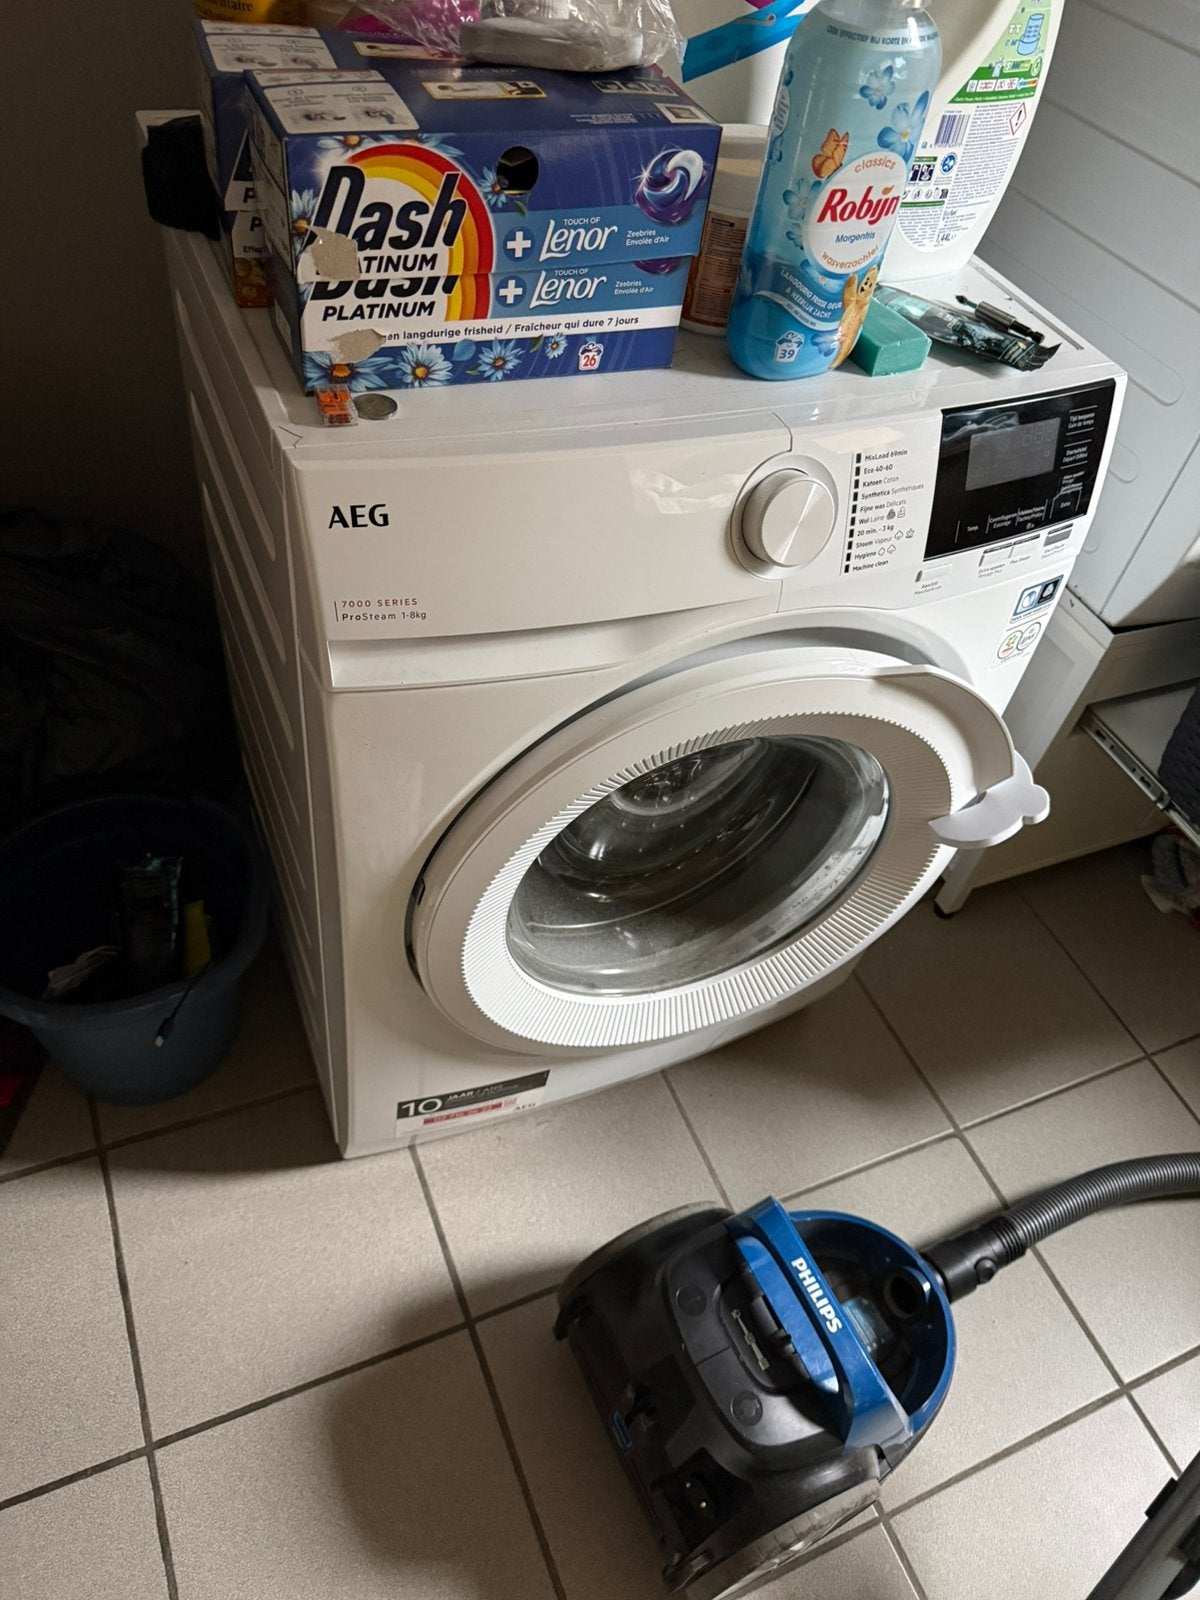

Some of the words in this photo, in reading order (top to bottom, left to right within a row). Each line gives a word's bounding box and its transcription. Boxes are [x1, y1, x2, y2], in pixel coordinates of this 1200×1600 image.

[869, 34, 881, 45] BIJ
[882, 36, 900, 46] KORTE
[854, 156, 897, 174] classics
[302, 165, 467, 252] Dash
[817, 185, 900, 226] Robijn
[564, 218, 589, 226] TOUCH
[590, 217, 600, 225] OF
[626, 229, 656, 238] Zeebries
[835, 231, 875, 244] Morgenfris
[539, 219, 618, 262] Lenor
[626, 238, 653, 247] Envolée
[654, 235, 669, 245] d'Air
[358, 253, 438, 275] TINUM
[555, 269, 578, 277] TOUCH
[579, 268, 589, 276] OF
[529, 270, 607, 310] Lenor
[615, 280, 642, 288] Zeebries
[780, 269, 812, 299] LANGDURIG
[614, 288, 639, 296] Envolée
[640, 286, 654, 294] d'Air
[322, 301, 436, 322] PLATINUM
[385, 332, 400, 341] en
[403, 328, 461, 343] langdurige
[464, 324, 503, 337] frisheid
[514, 321, 561, 333] Fraîcheur
[565, 319, 580, 331] qui
[582, 317, 604, 328] dure
[608, 317, 614, 326] 7
[615, 315, 639, 327] jours
[779, 349, 795, 360] 39
[583, 355, 597, 368] 26
[865, 451, 889, 462] MixLoad
[890, 449, 908, 458] 69min
[864, 466, 874, 475] Eco
[875, 464, 894, 473] 40-60
[862, 478, 882, 488] Katoen
[883, 476, 899, 485] Coton
[861, 489, 890, 500] Synthetica
[860, 504, 874, 513] Fijne
[328, 503, 390, 529] AEG
[859, 516, 870, 525] Wol
[870, 515, 885, 523] Laine
[857, 529, 865, 537] 20
[886, 525, 894, 533] kg
[856, 540, 873, 549] Stoom
[854, 550, 876, 560] Hygiene
[852, 562, 874, 572] Machine
[875, 559, 889, 568] clean
[342, 600, 371, 608] 7000
[377, 598, 418, 607] SERIES
[342, 613, 396, 621] ProSteam
[401, 611, 427, 620] 1-8kg
[401, 1098, 442, 1117] 10
[791, 1256, 843, 1334] PHILIPS
